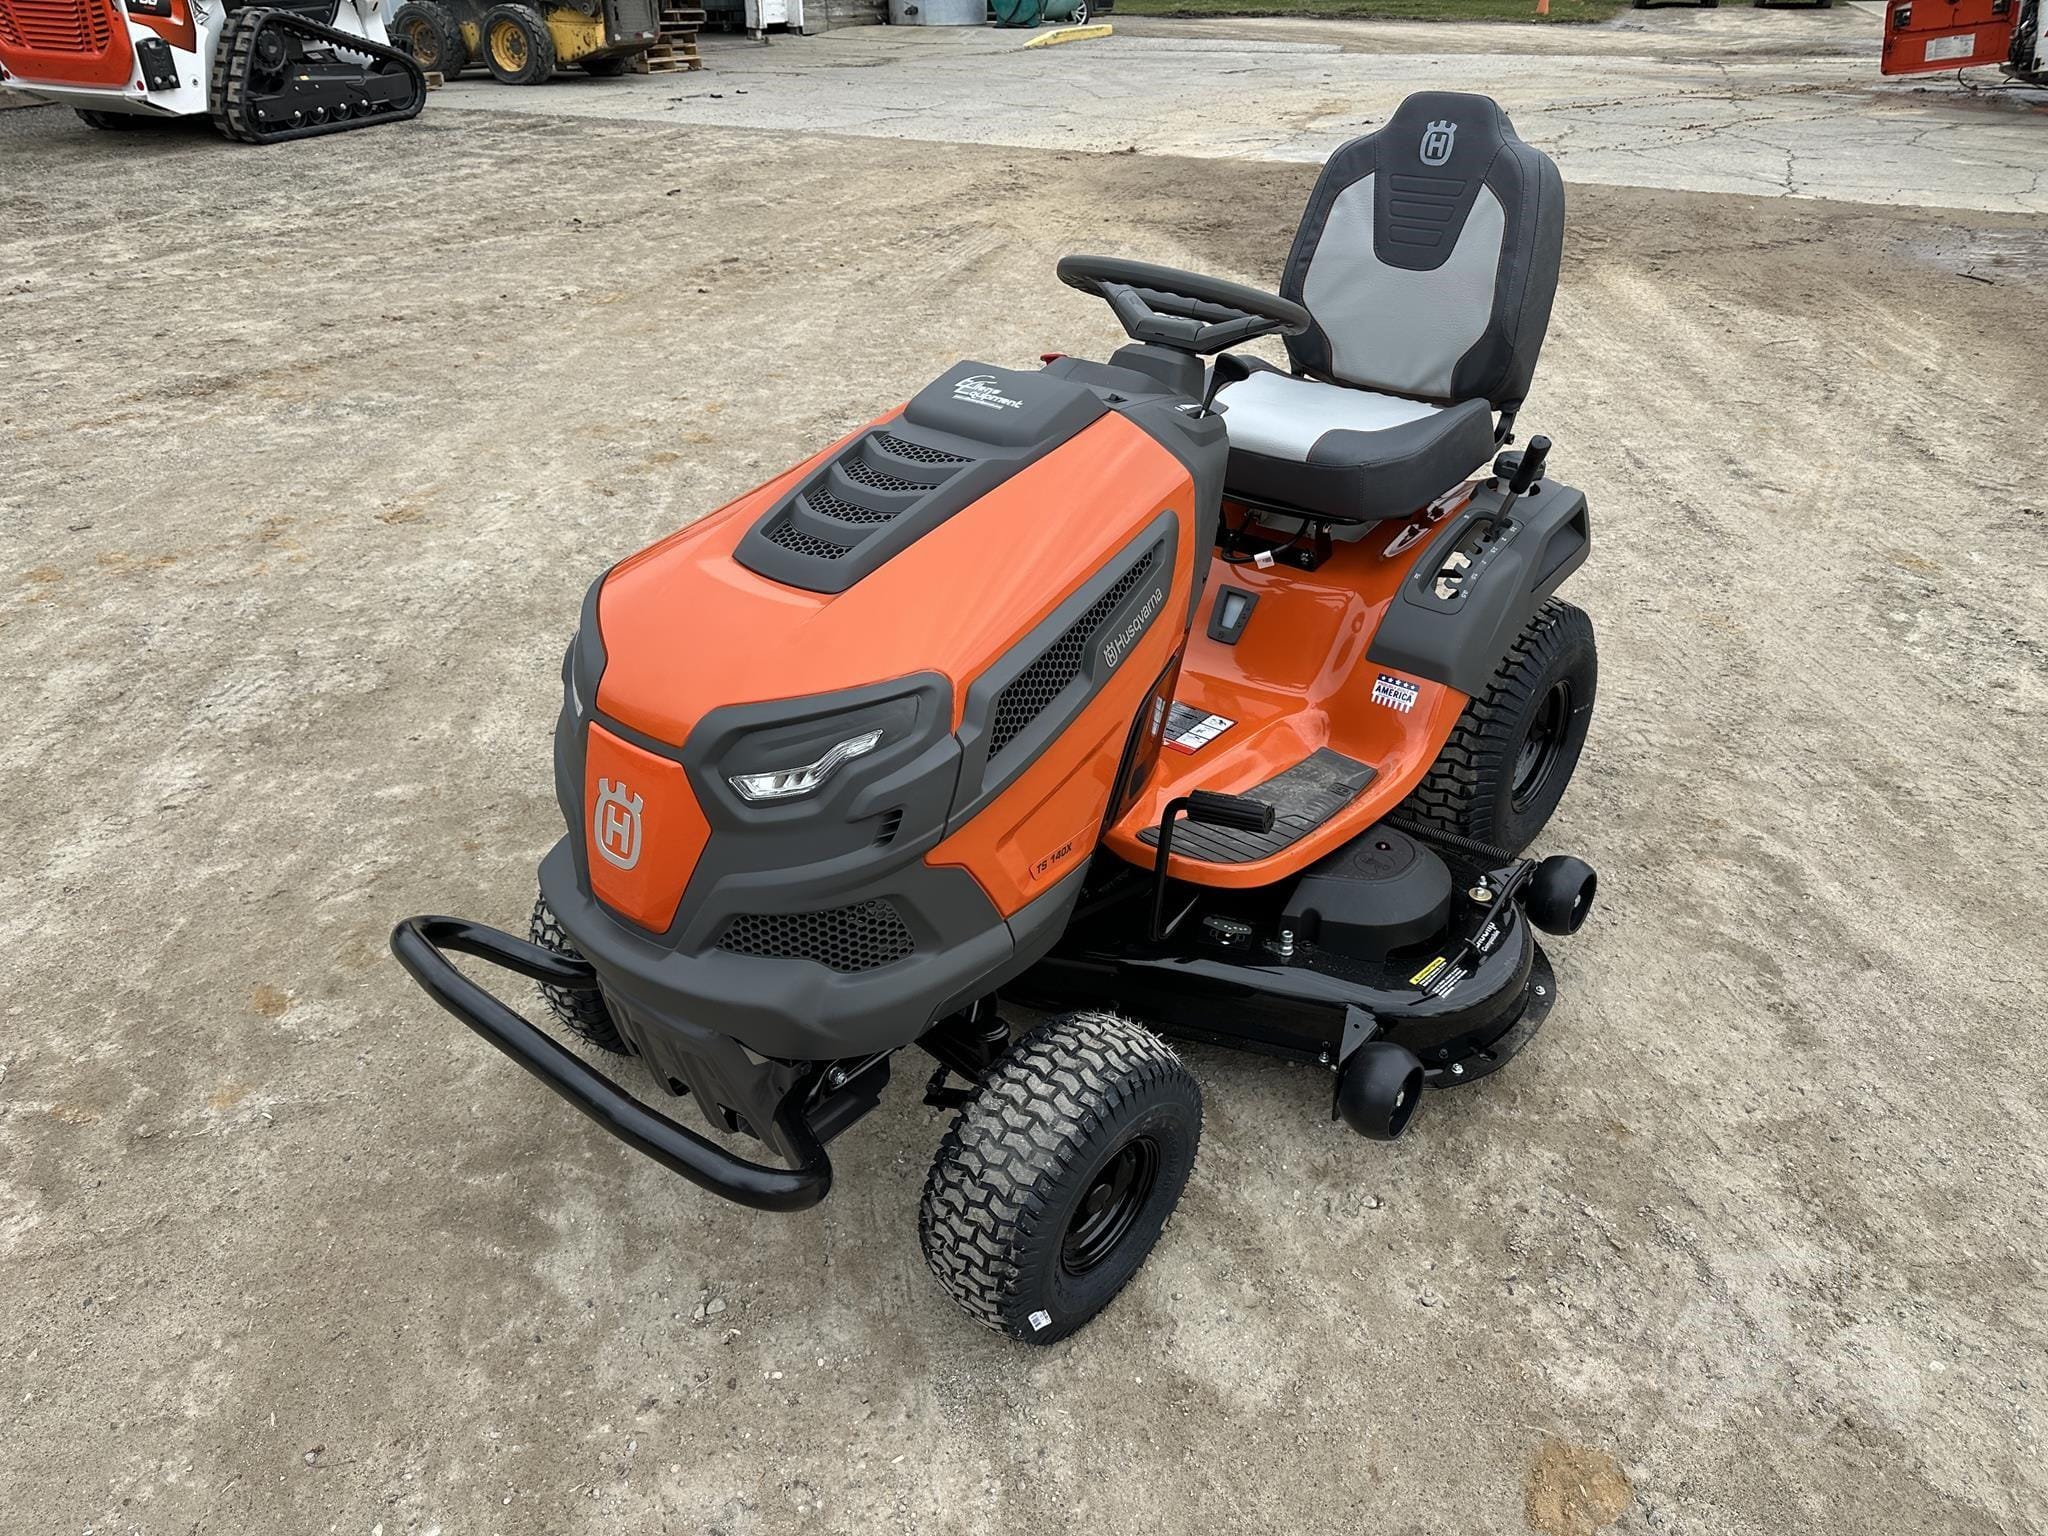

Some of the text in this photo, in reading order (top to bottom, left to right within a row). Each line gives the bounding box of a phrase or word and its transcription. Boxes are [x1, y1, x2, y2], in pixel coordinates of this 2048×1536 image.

[1114, 588, 1162, 654] Husqvarna
[1375, 685, 1412, 703] AMERICA
[1036, 841, 1073, 874] TS 140X
